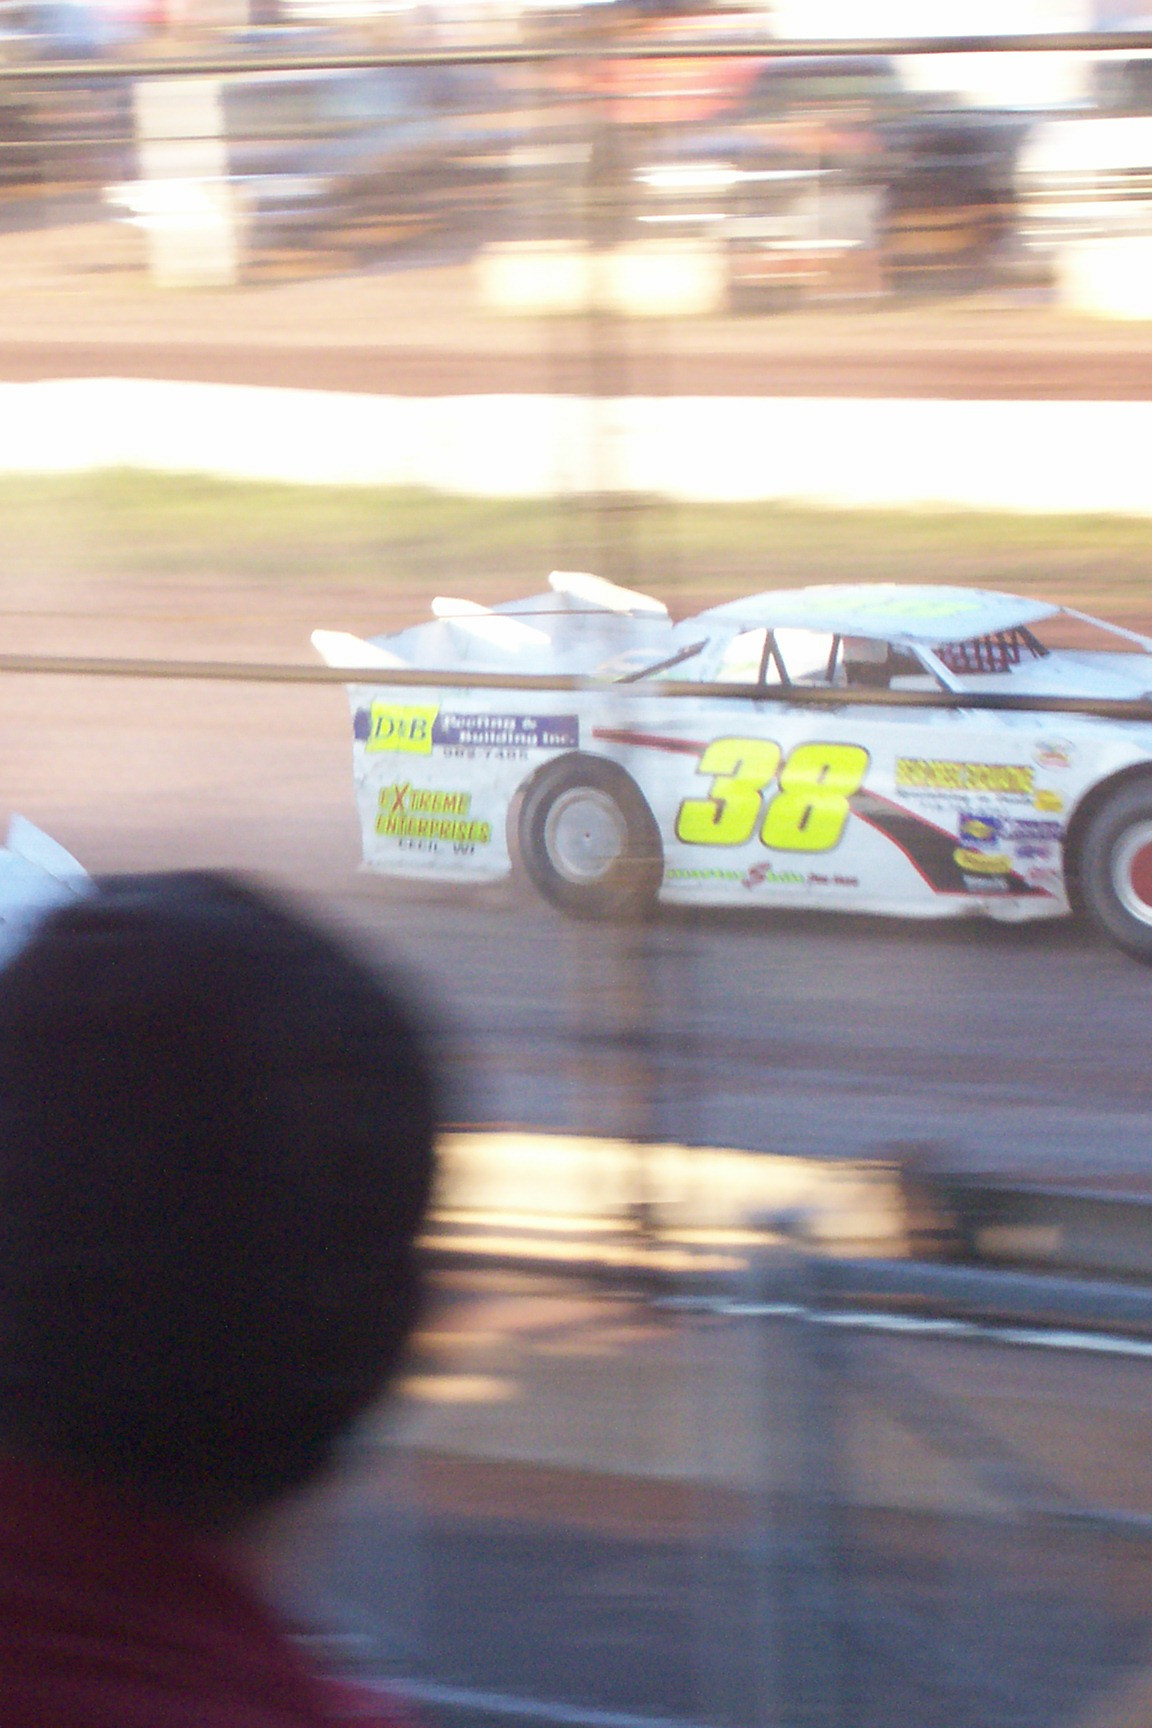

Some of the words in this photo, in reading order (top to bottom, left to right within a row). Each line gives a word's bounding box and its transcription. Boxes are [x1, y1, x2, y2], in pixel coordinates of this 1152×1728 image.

[379, 782, 472, 816] EXTREME
[675, 736, 870, 853] 38
[375, 814, 492, 844] ENTERPRISES
